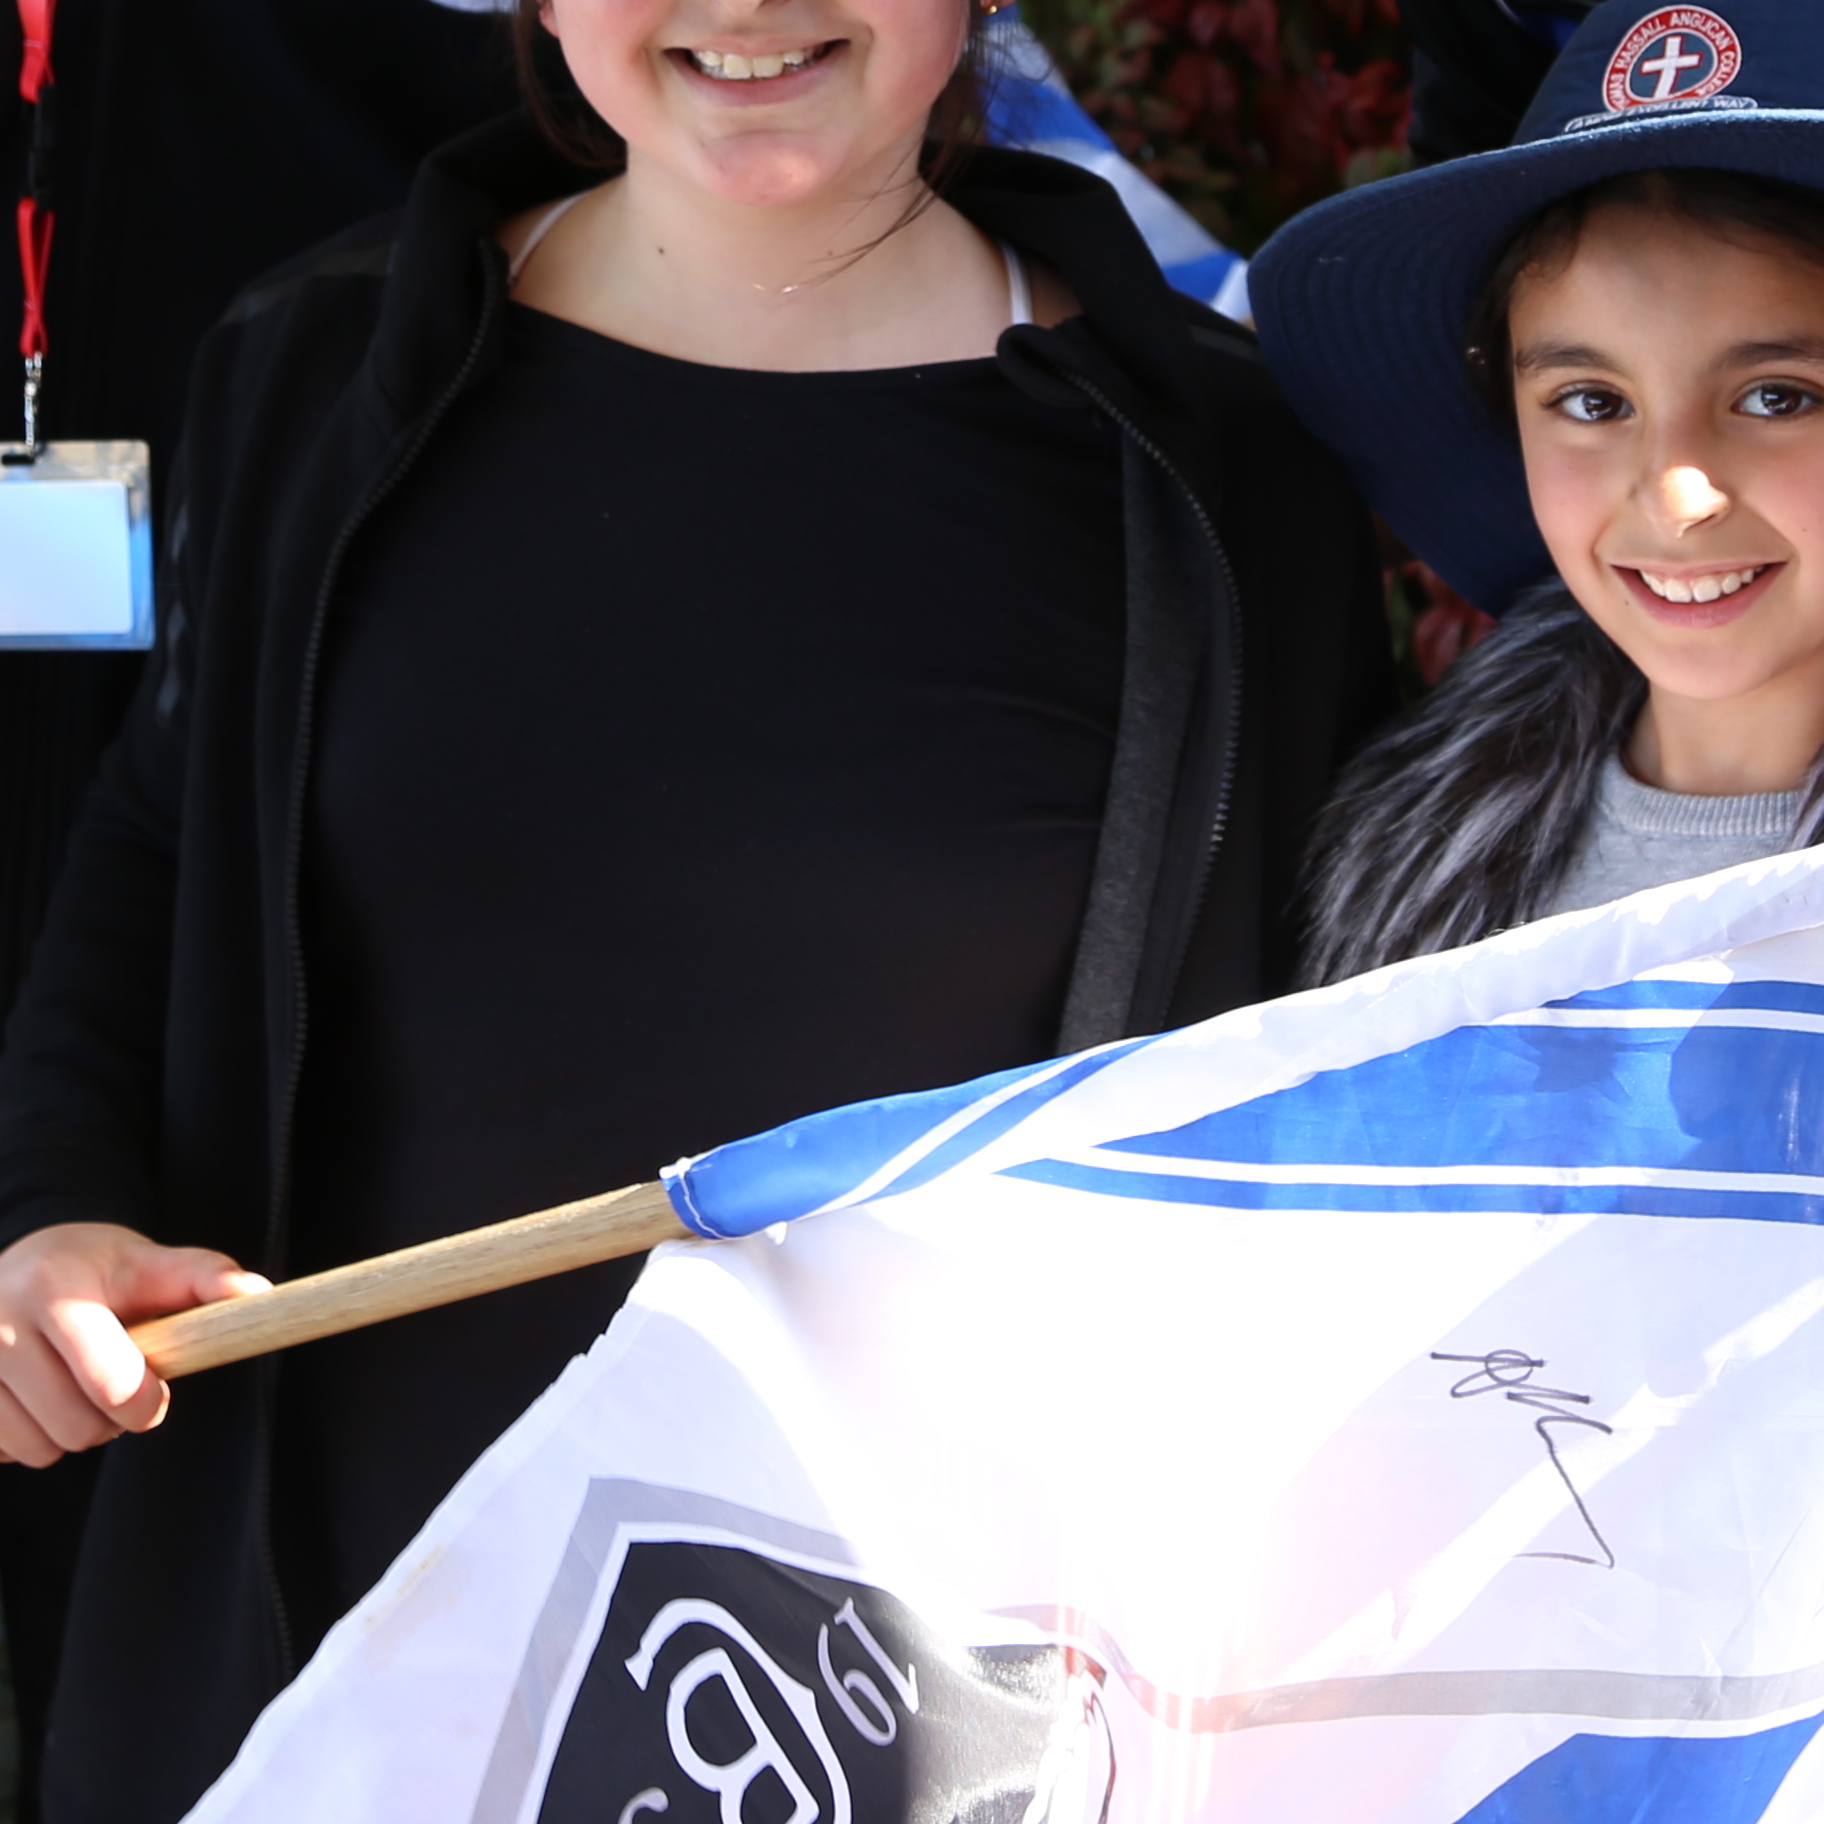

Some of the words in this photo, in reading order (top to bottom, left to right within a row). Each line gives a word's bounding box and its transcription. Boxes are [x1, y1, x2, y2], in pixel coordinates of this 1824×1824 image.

[1615, 18, 1667, 69] HASSALL
[1670, 11, 1733, 51] ANGLICAN
[1610, 74, 1629, 109] OMAS
[1694, 50, 1736, 97] COLLEGE
[1714, 97, 1750, 110] WAY
[817, 1596, 919, 1746] 19
